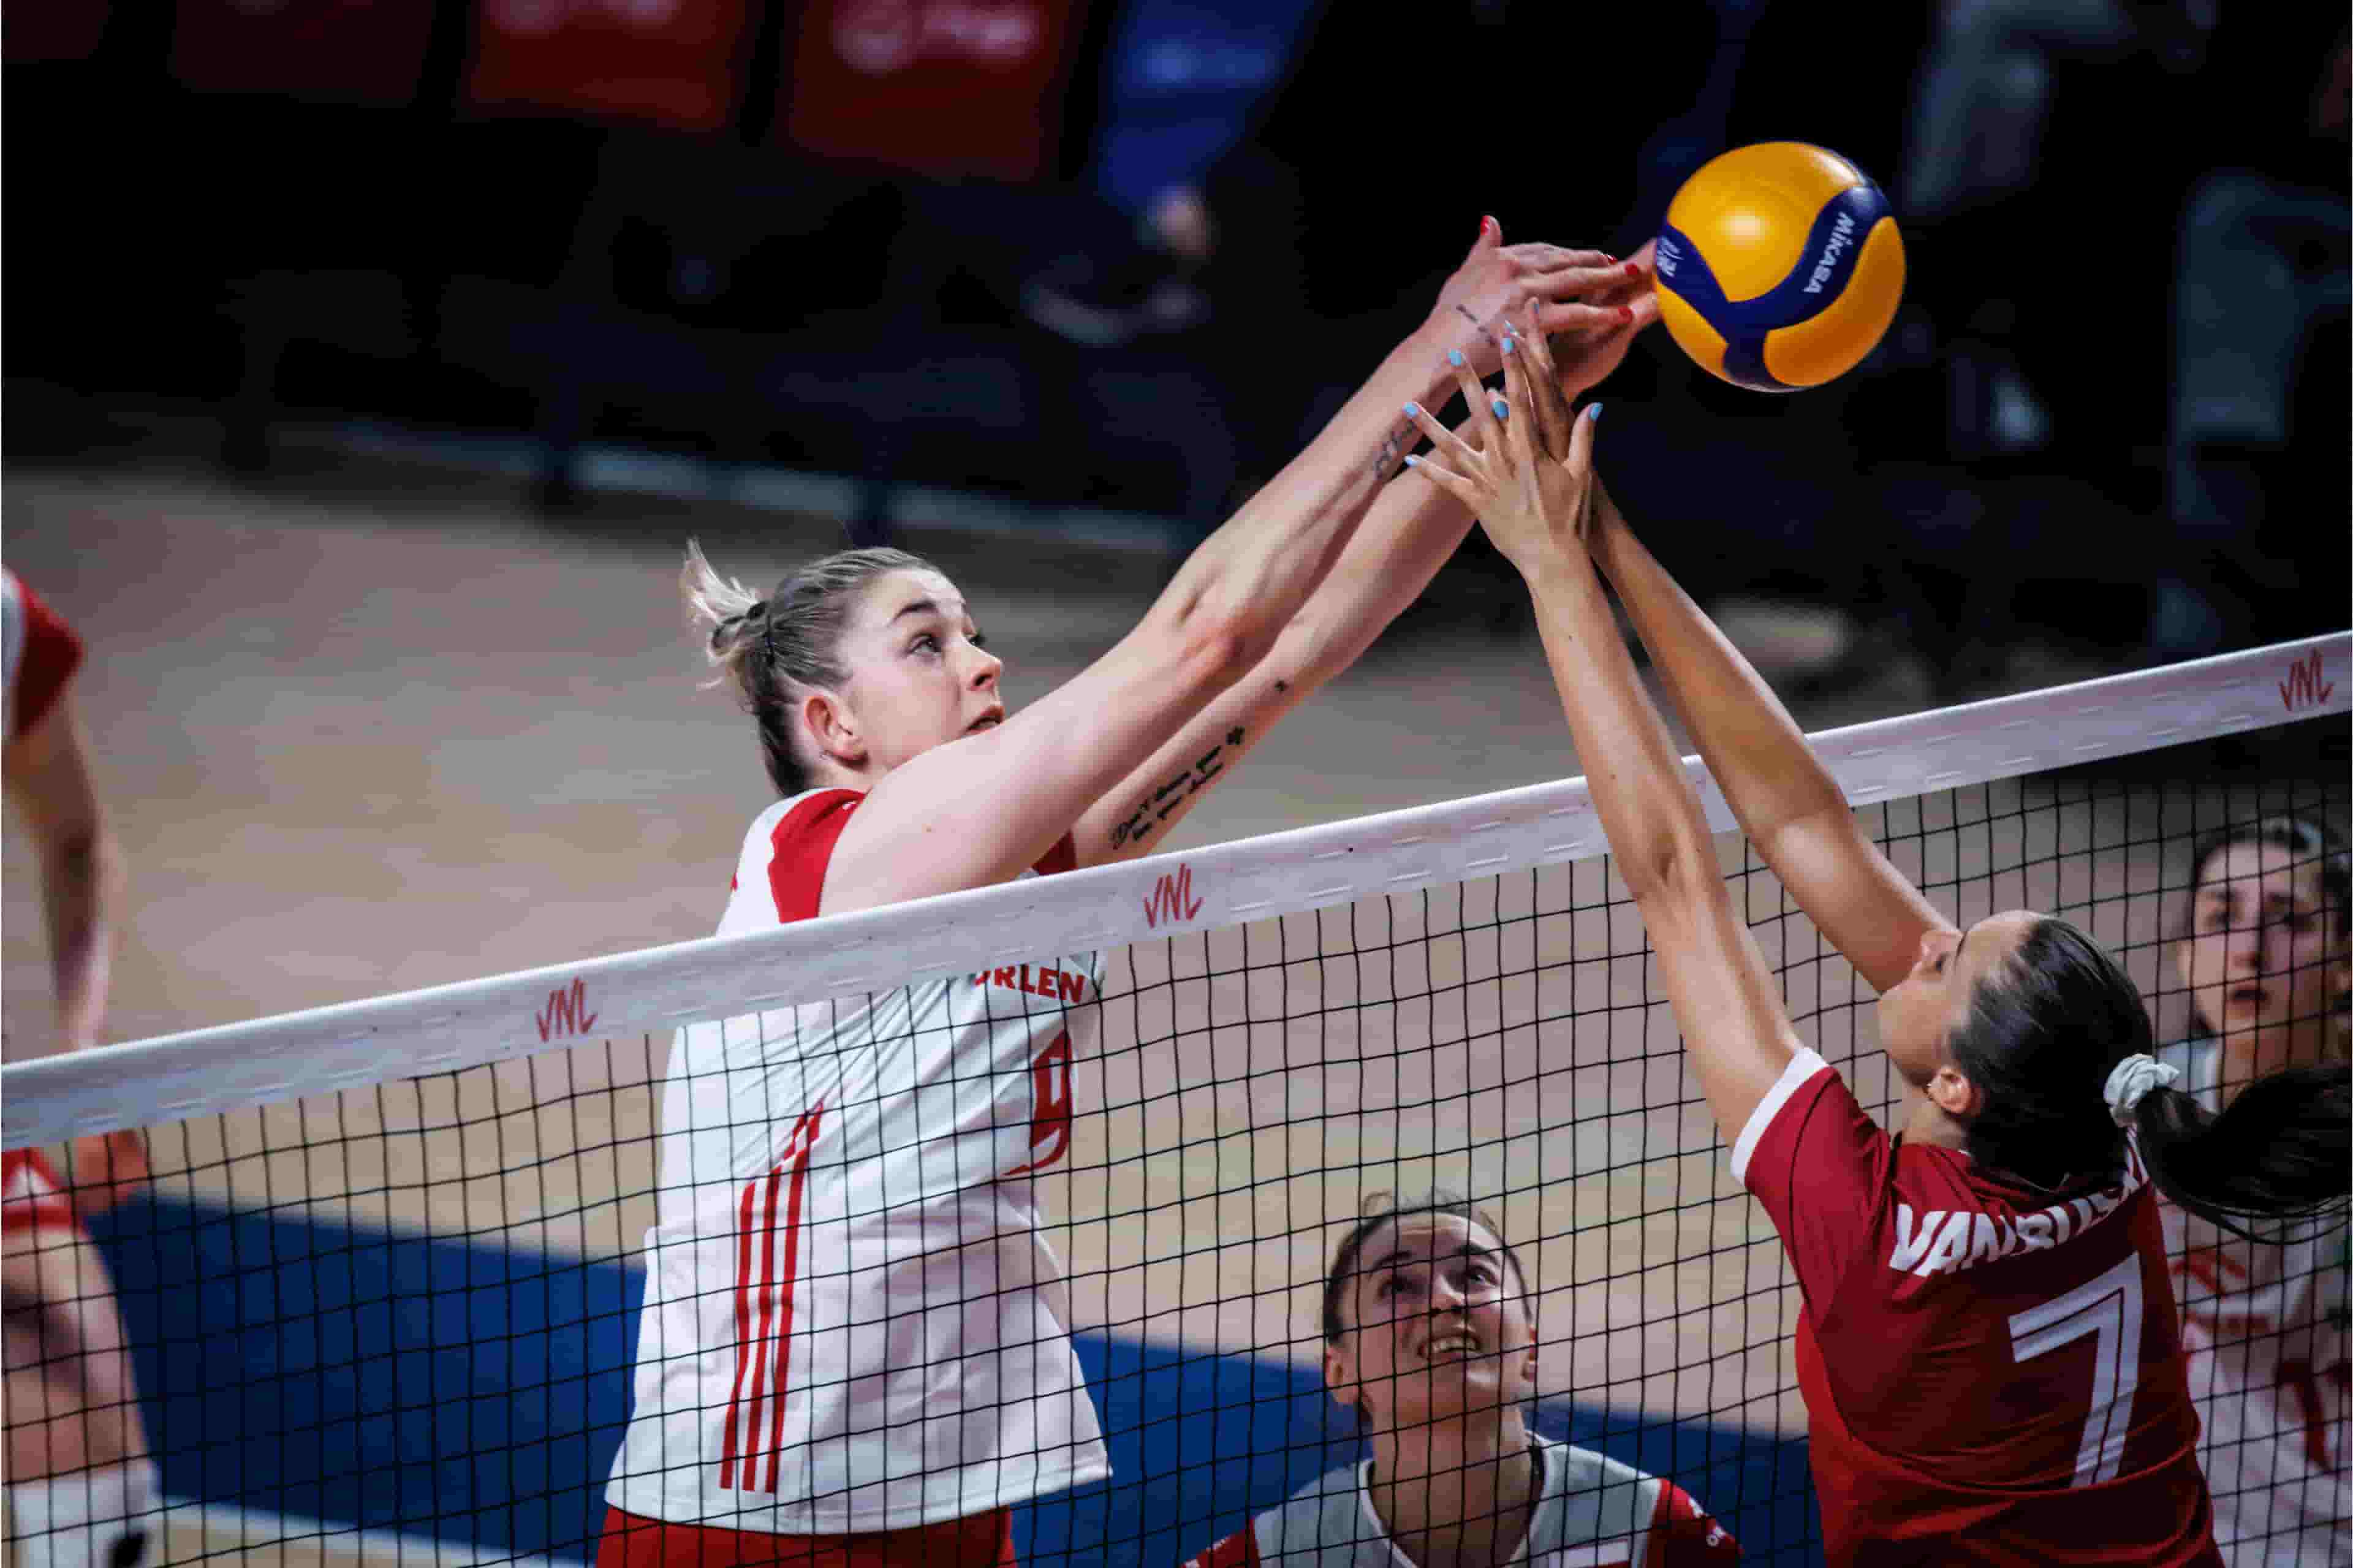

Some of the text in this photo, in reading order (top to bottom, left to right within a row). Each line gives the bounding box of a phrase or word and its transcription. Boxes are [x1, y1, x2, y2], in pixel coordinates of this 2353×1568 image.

[2279, 648, 2333, 710] VNL
[1143, 863, 1205, 928] VNL
[536, 975, 598, 1043] VNL
[2009, 1251, 2143, 1488] 7
